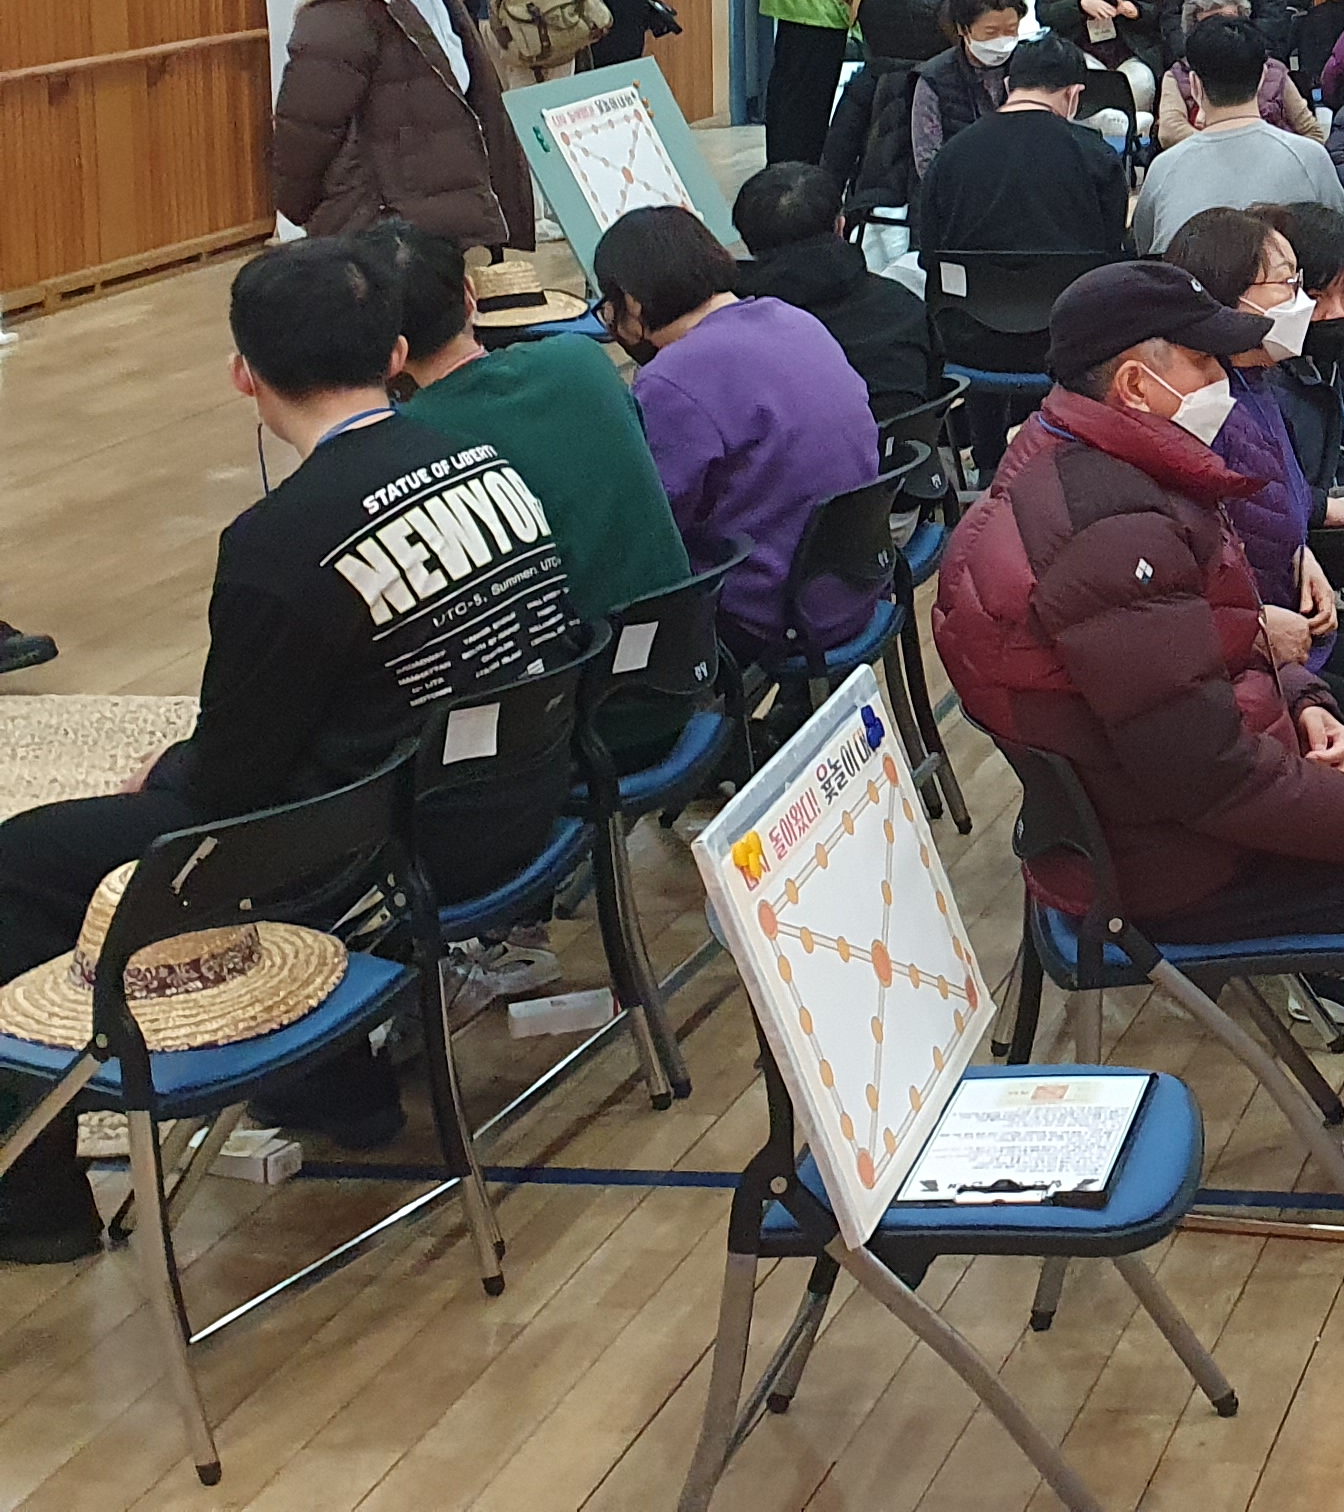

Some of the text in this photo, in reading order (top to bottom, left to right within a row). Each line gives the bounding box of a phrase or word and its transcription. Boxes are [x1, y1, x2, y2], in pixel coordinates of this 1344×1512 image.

[334, 467, 552, 626] NEWYOR
[362, 467, 432, 515] STATUE
[430, 458, 451, 479] OF
[768, 787, 822, 861] 돌아왔다!
[816, 740, 861, 806] 윷놀이
